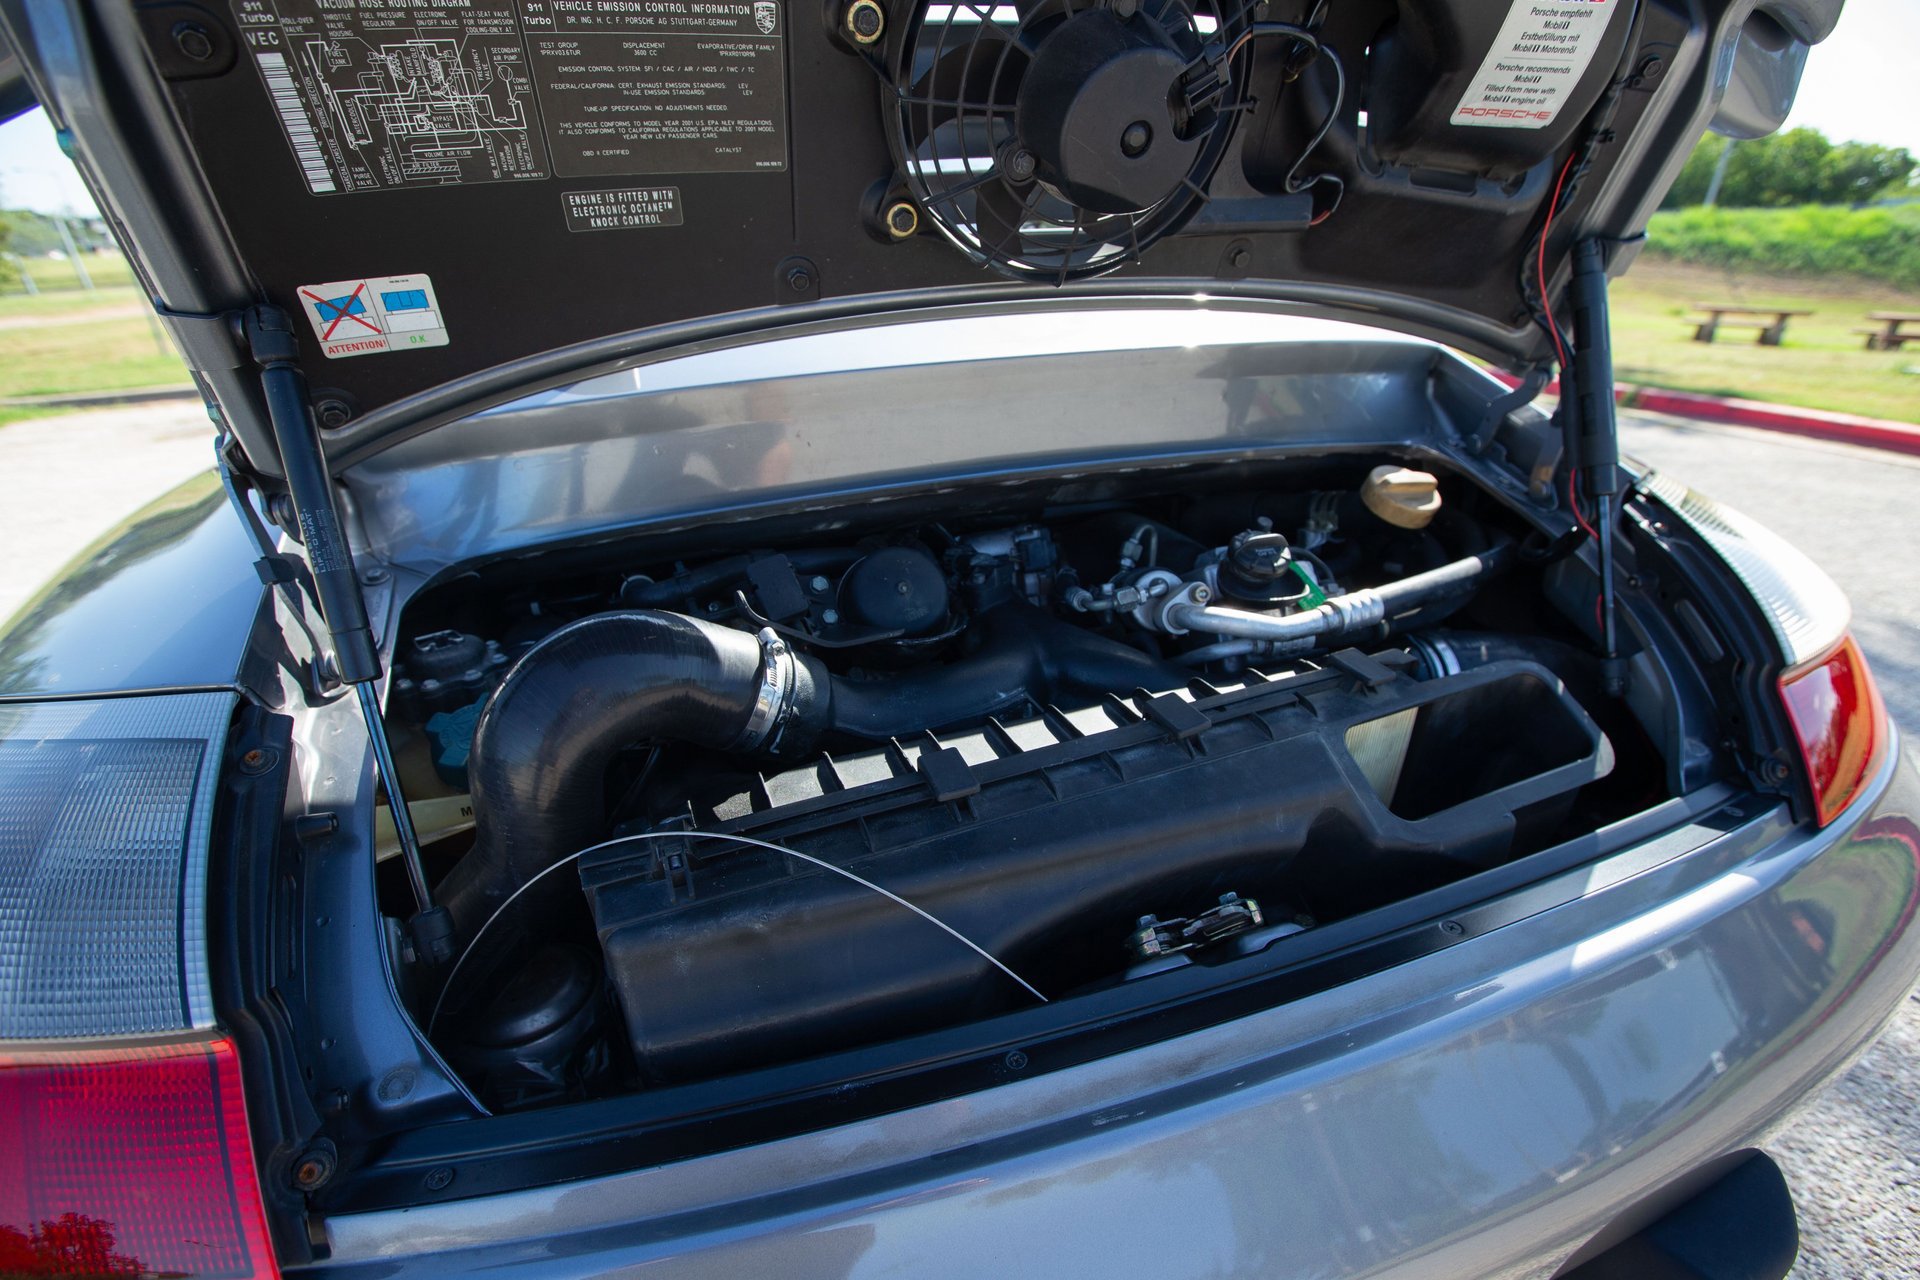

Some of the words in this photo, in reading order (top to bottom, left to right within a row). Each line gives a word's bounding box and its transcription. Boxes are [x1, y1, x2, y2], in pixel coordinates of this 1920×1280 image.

[242, 2, 263, 11] 911
[316, 0, 356, 9] VACUUM
[359, 0, 384, 8] HOSE
[388, 0, 428, 8] ROUTING
[431, 0, 471, 8] DIAGRAM
[528, 3, 543, 12] 911
[553, 1, 592, 11] VEHICLE
[597, 2, 640, 12] EMISSION
[645, 2, 687, 13] CONTROL
[691, 3, 750, 15] INFORMATION
[323, 13, 352, 21] THROTTLE
[360, 11, 374, 19] FUEL
[377, 11, 407, 19] PRESSURE
[414, 11, 448, 19] ELECTRONIC
[1530, 7, 1558, 17] Porsche
[1560, 9, 1593, 19] empfiehlt
[240, 13, 275, 23] Turbo
[281, 17, 314, 25] ROLL-OVER
[478, 18, 514, 26] TRANSMISSION
[524, 16, 551, 25] Turbo
[567, 16, 578, 24] DR.
[625, 16, 654, 25] PORSCHE
[658, 17, 667, 25] AG
[671, 17, 738, 27] STUTTGART-GERMANY
[362, 20, 396, 28] REGULATOR
[416, 19, 438, 27] ON/OFF
[247, 32, 279, 46] VEC
[1520, 31, 1567, 44] Erstbefüllung
[1567, 34, 1580, 42] mit
[697, 42, 753, 50] EVAPORATIVE/ORVR
[1540, 45, 1577, 54] Motorenöl
[1495, 63, 1524, 72] Porsche
[1525, 65, 1571, 74] recommends
[1484, 84, 1505, 93] Filled
[1505, 85, 1522, 93] from
[1540, 86, 1556, 95] with
[1511, 97, 1535, 105] engine
[1458, 107, 1552, 120] PORSCHE
[569, 193, 602, 206] ENGINE
[605, 193, 615, 203] IS
[618, 191, 649, 202] FITTED
[651, 190, 673, 201] WITH
[572, 204, 627, 217] ELECTRONIC
[590, 216, 619, 228] KNOCK
[622, 213, 662, 225] CONTROL
[328, 339, 386, 354] ATTENTION!
